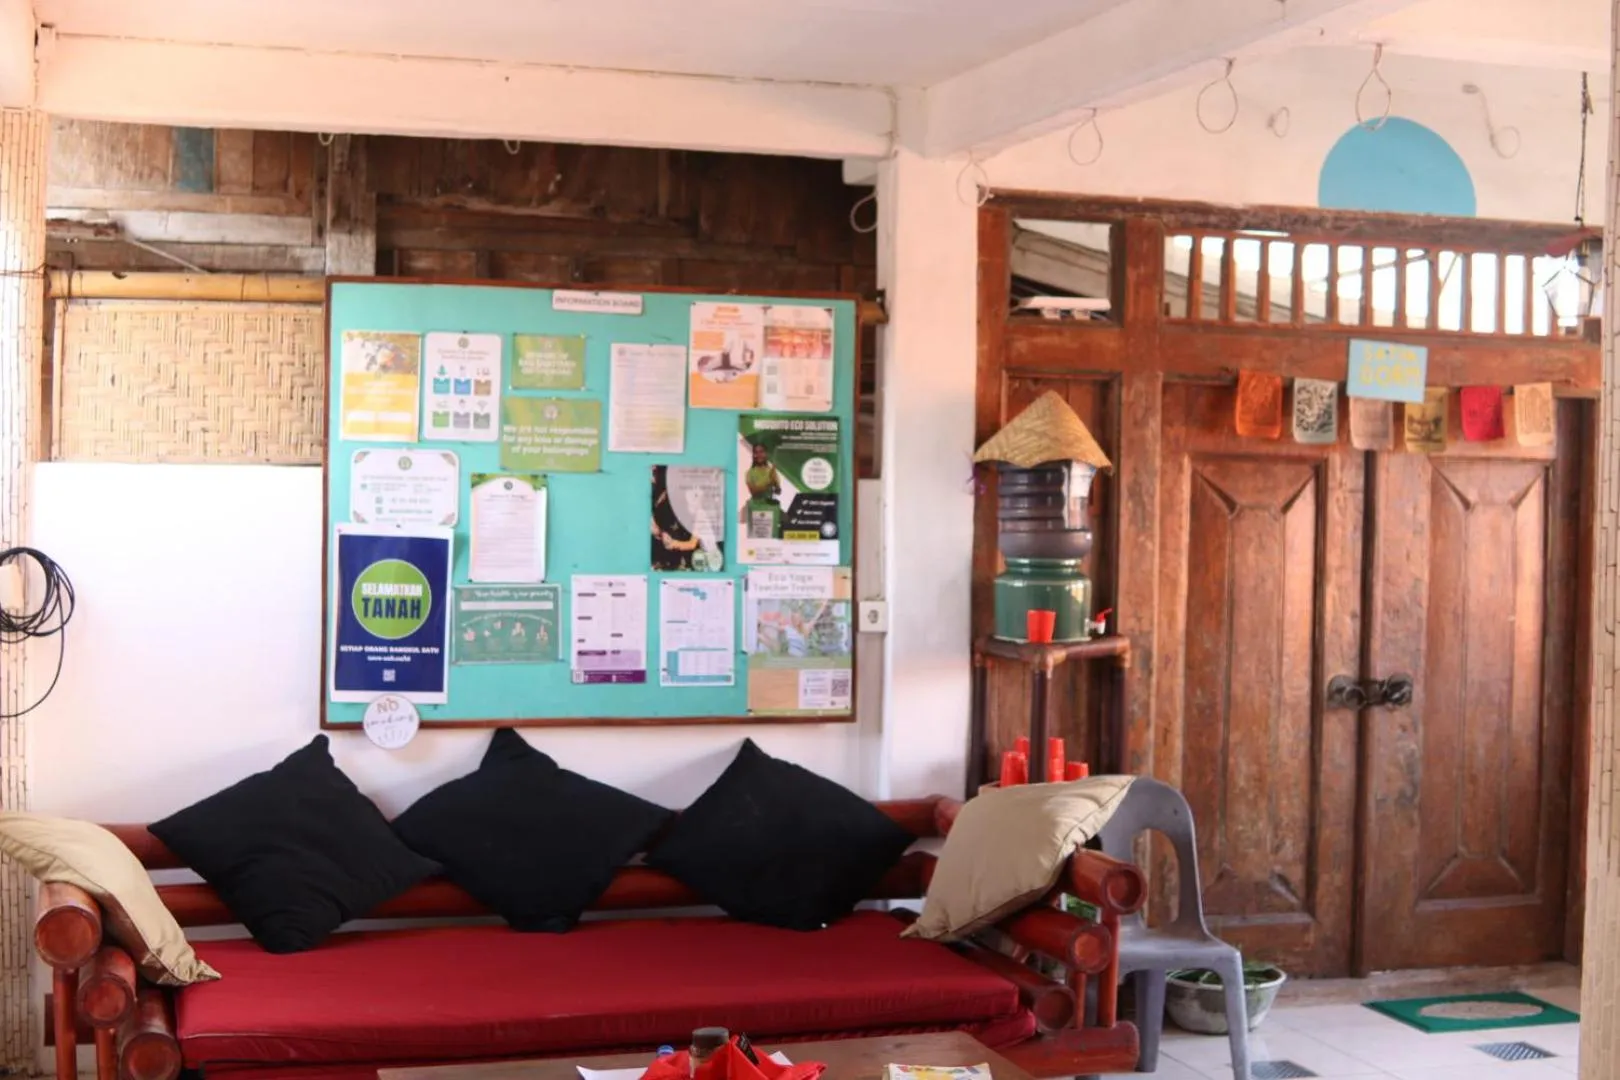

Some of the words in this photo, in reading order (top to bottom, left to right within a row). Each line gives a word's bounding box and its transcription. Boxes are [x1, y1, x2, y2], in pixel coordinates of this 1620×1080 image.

[554, 296, 611, 306] INFORMATION
[612, 299, 641, 308] BOARD
[790, 420, 803, 430] ECO
[549, 427, 599, 436] responsible
[517, 436, 532, 445] any
[533, 435, 551, 443] loss
[564, 436, 598, 447] damage
[511, 445, 521, 454] of
[522, 446, 541, 455] your
[542, 445, 589, 456] belongings
[768, 573, 786, 582] Eco
[790, 574, 813, 584] Yoga
[361, 583, 423, 597] SELAMATKAN
[754, 583, 789, 591] Teacher
[791, 583, 826, 593] Training
[361, 597, 421, 618] TANAH
[364, 645, 388, 653] ORANG
[421, 646, 440, 654] SATU
[376, 700, 400, 714] NO
